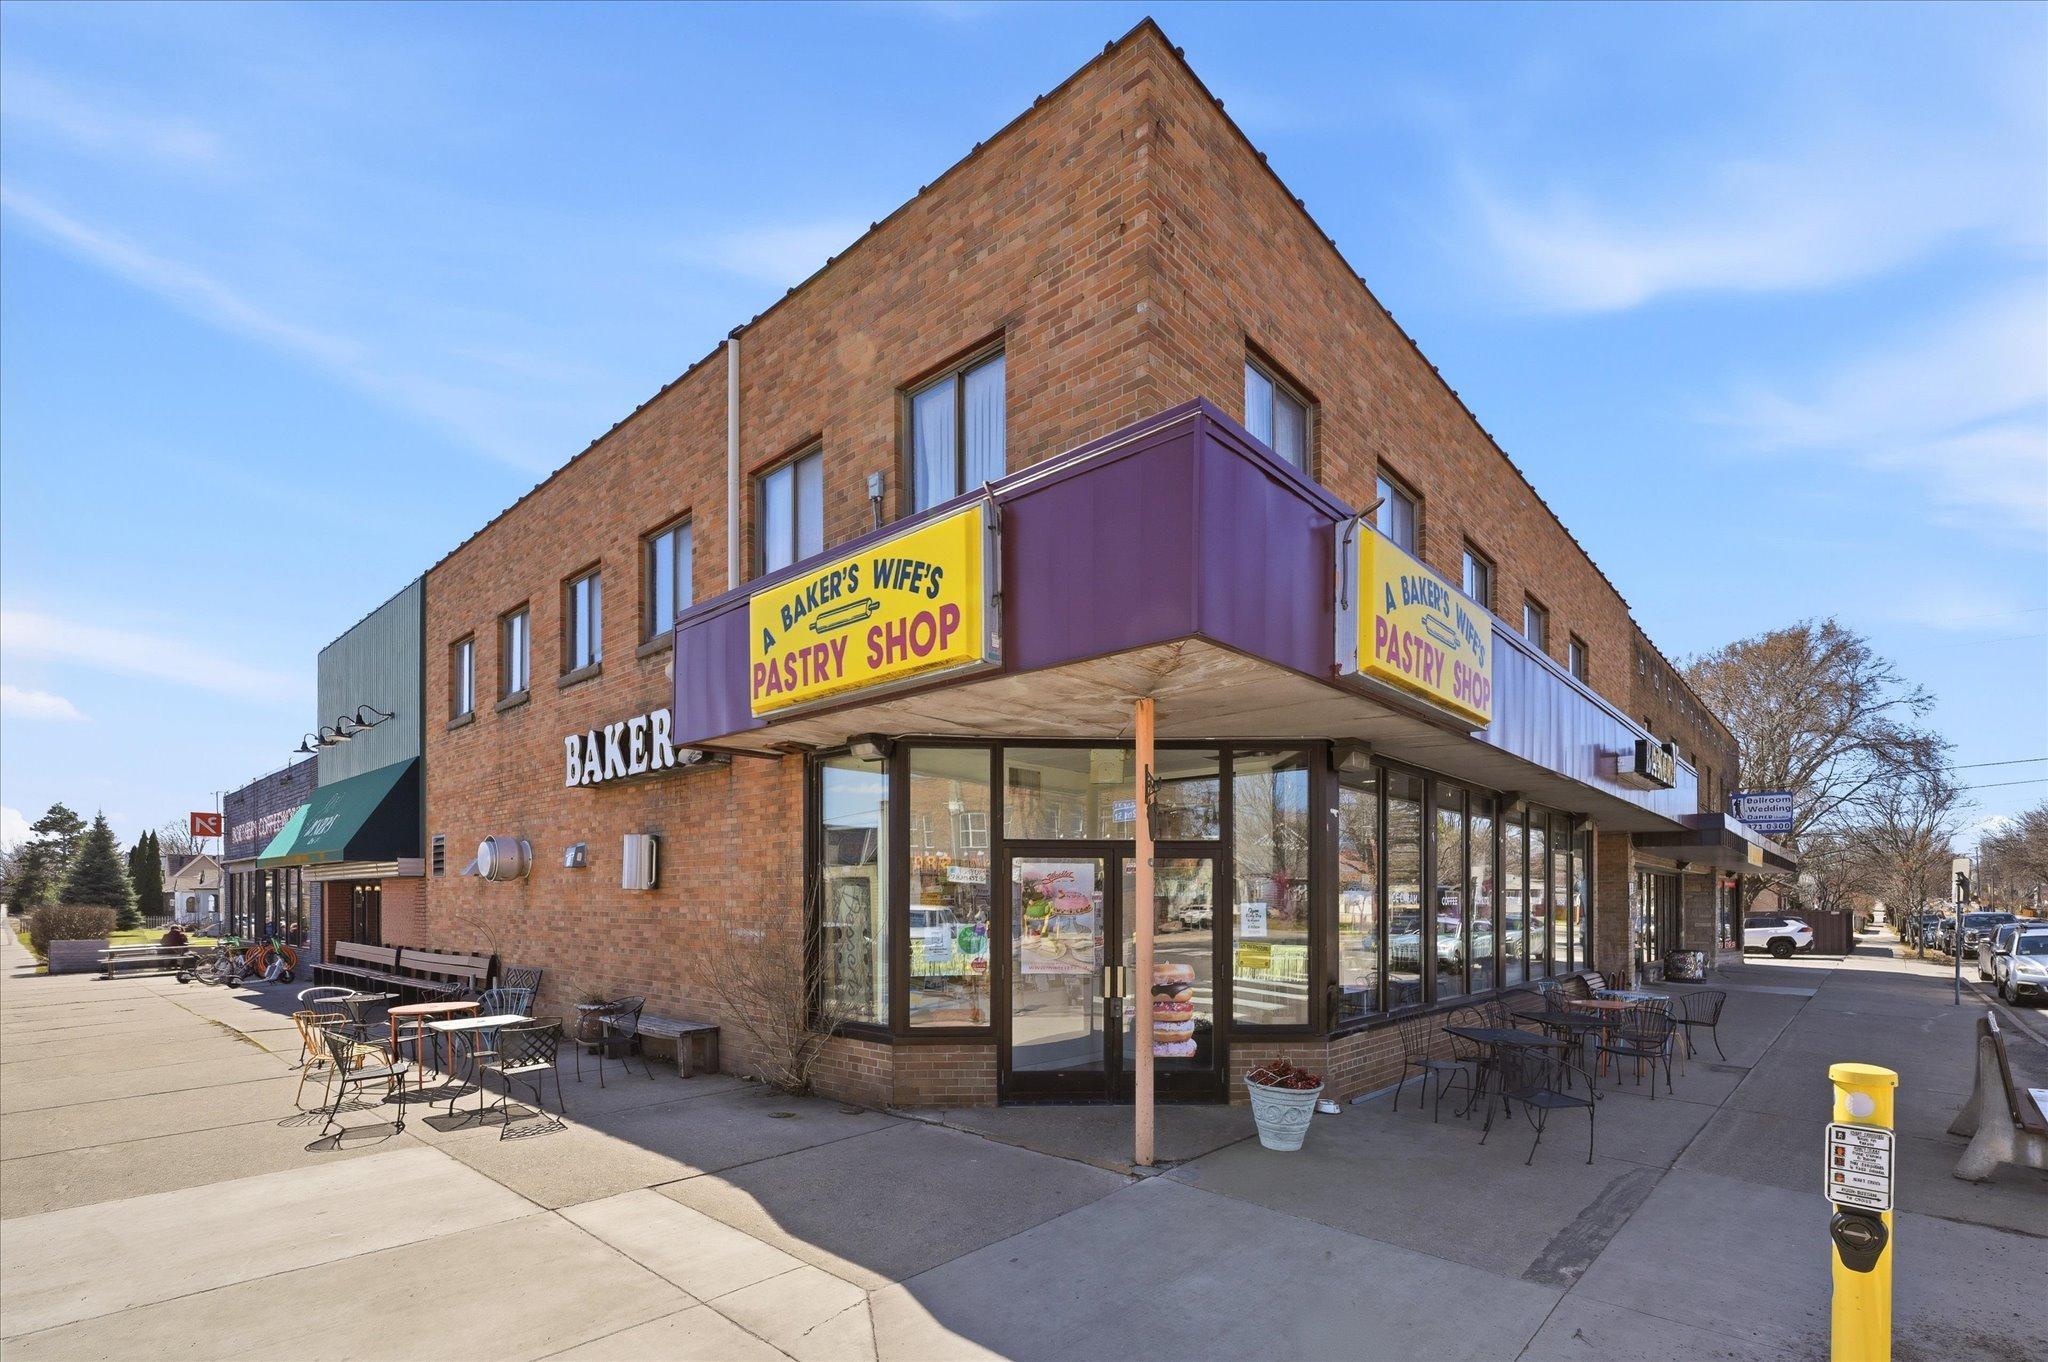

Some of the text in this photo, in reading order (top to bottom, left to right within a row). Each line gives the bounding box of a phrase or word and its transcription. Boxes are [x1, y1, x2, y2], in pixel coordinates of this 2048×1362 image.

[753, 602, 961, 700] PASTRY SHOP
[762, 558, 944, 655] A BAKER'S WIFE'S
[1384, 575, 1486, 669] A BAKER'S WIFE'S
[1374, 614, 1490, 711] PASTRY SHOP
[564, 708, 675, 788] BAKER
[1441, 896, 1458, 906] COFFEE
